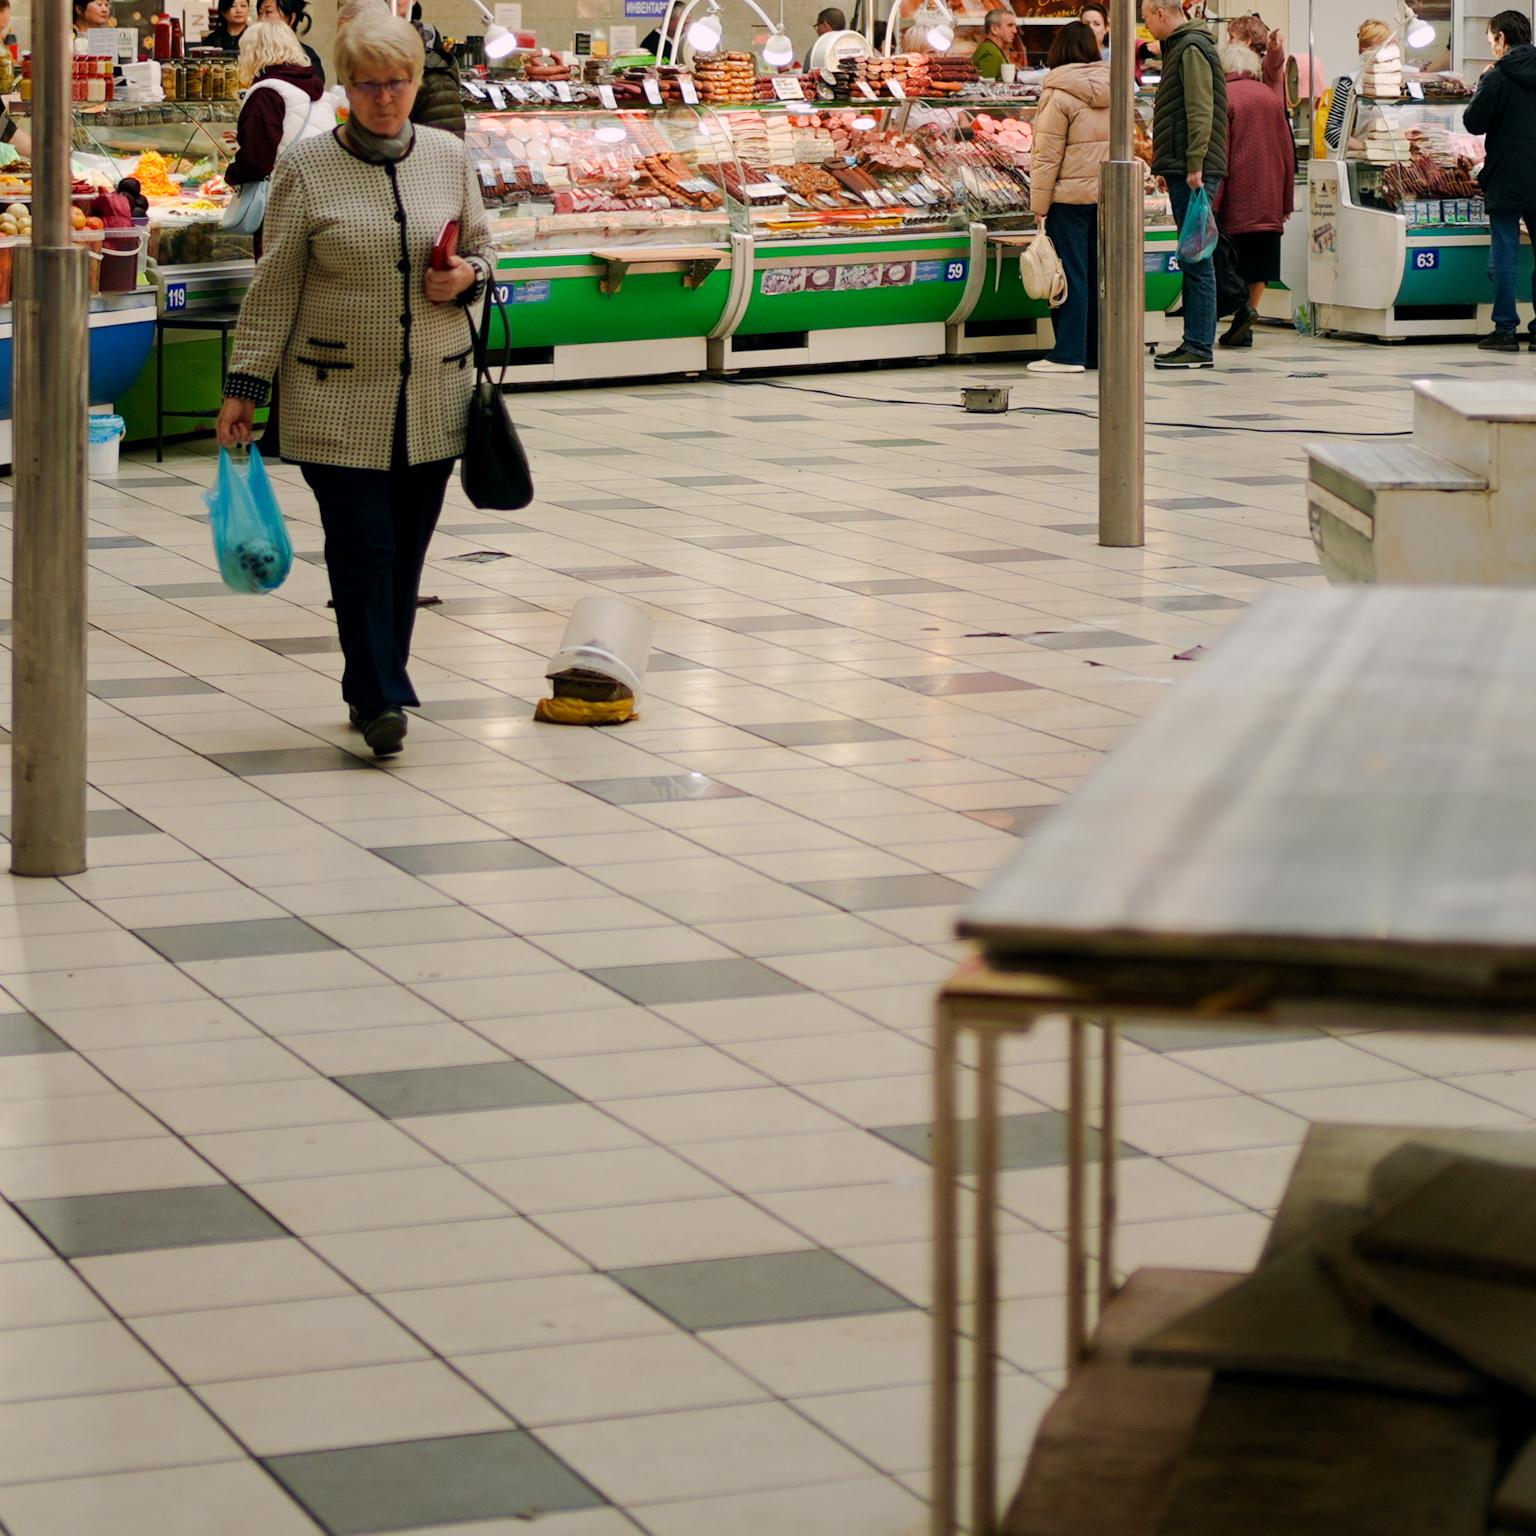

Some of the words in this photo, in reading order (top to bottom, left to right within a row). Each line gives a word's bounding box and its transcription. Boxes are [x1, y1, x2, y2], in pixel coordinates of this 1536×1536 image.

[626, 1, 669, 14] ИНВЕНТАР
[1417, 253, 1434, 267] 63
[947, 264, 963, 279] 59
[168, 288, 185, 307] 119
